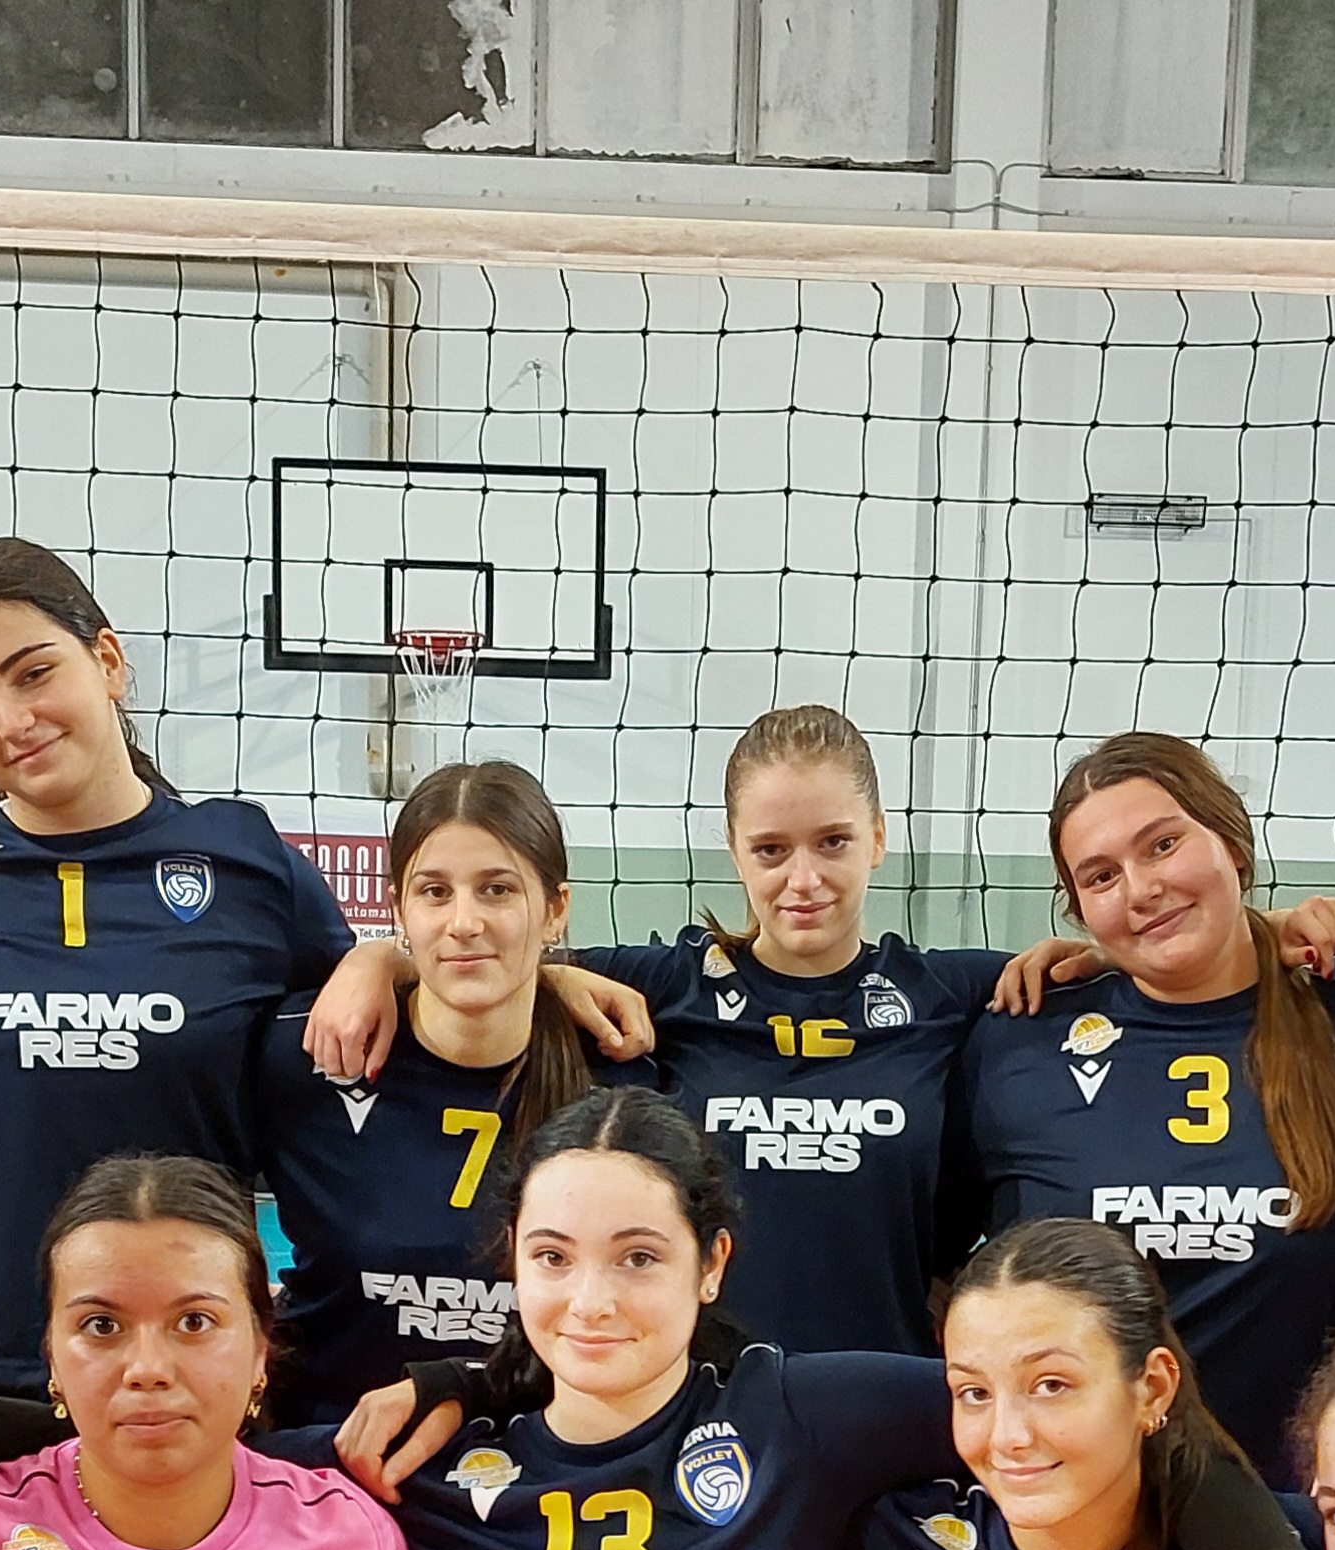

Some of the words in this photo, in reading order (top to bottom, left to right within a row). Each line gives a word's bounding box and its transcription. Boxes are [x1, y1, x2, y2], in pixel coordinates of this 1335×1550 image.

[57, 862, 86, 947] 1
[19, 1030, 140, 1070] RES
[705, 1096, 906, 1136] FARMO
[1167, 1055, 1230, 1143] 3
[442, 1108, 502, 1208] 7
[745, 1133, 862, 1172] RES
[1093, 1185, 1302, 1228] FARMO
[1134, 1223, 1255, 1262] RES
[398, 1305, 508, 1344] RES
[679, 1421, 739, 1456] ERVIA
[684, 1449, 733, 1474] VOLLEY
